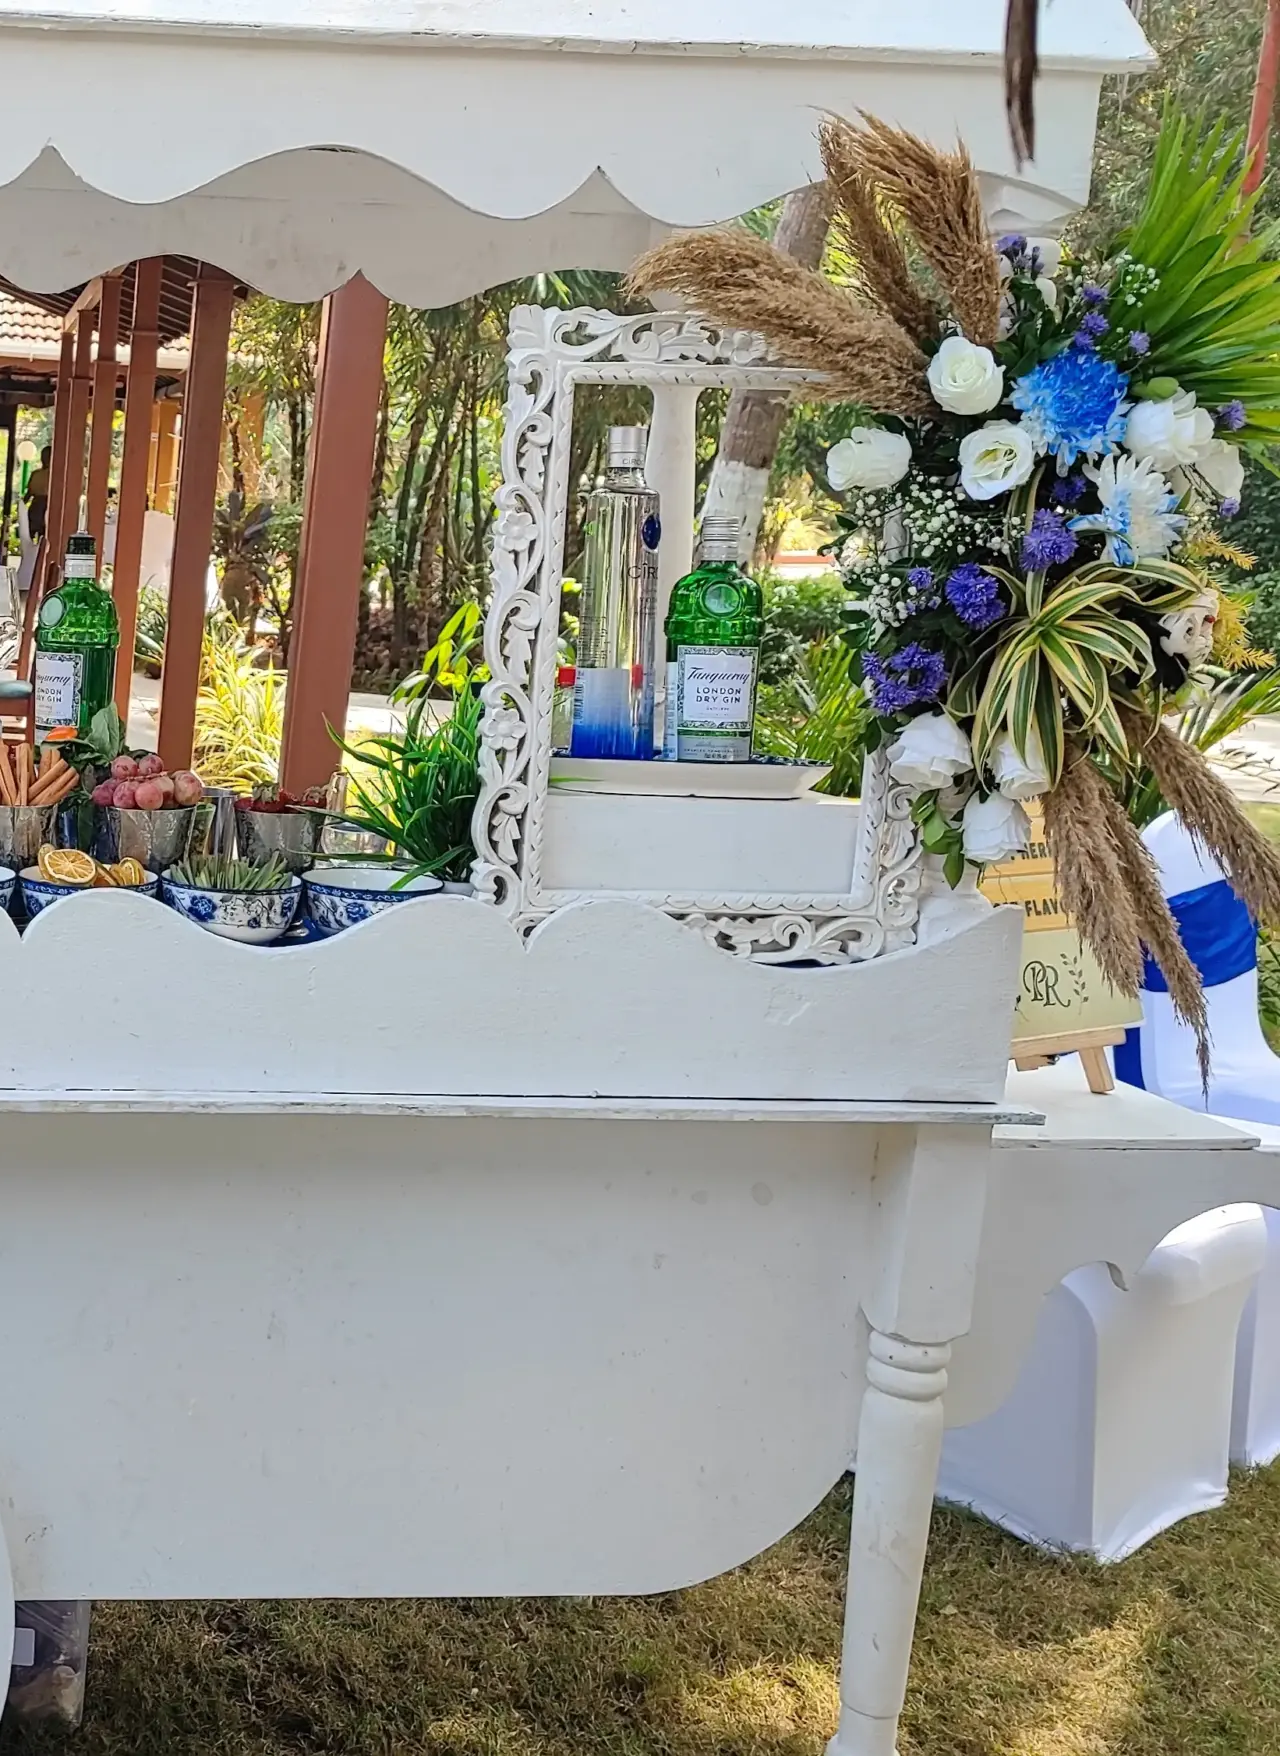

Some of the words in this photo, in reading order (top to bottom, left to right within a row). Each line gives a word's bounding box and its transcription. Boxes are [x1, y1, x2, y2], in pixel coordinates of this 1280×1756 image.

[687, 666, 750, 685] Tanqueray
[696, 686, 742, 695] LONDON
[696, 695, 719, 704] DRY
[722, 695, 741, 704] GIN
[1024, 898, 1060, 918] FLAV
